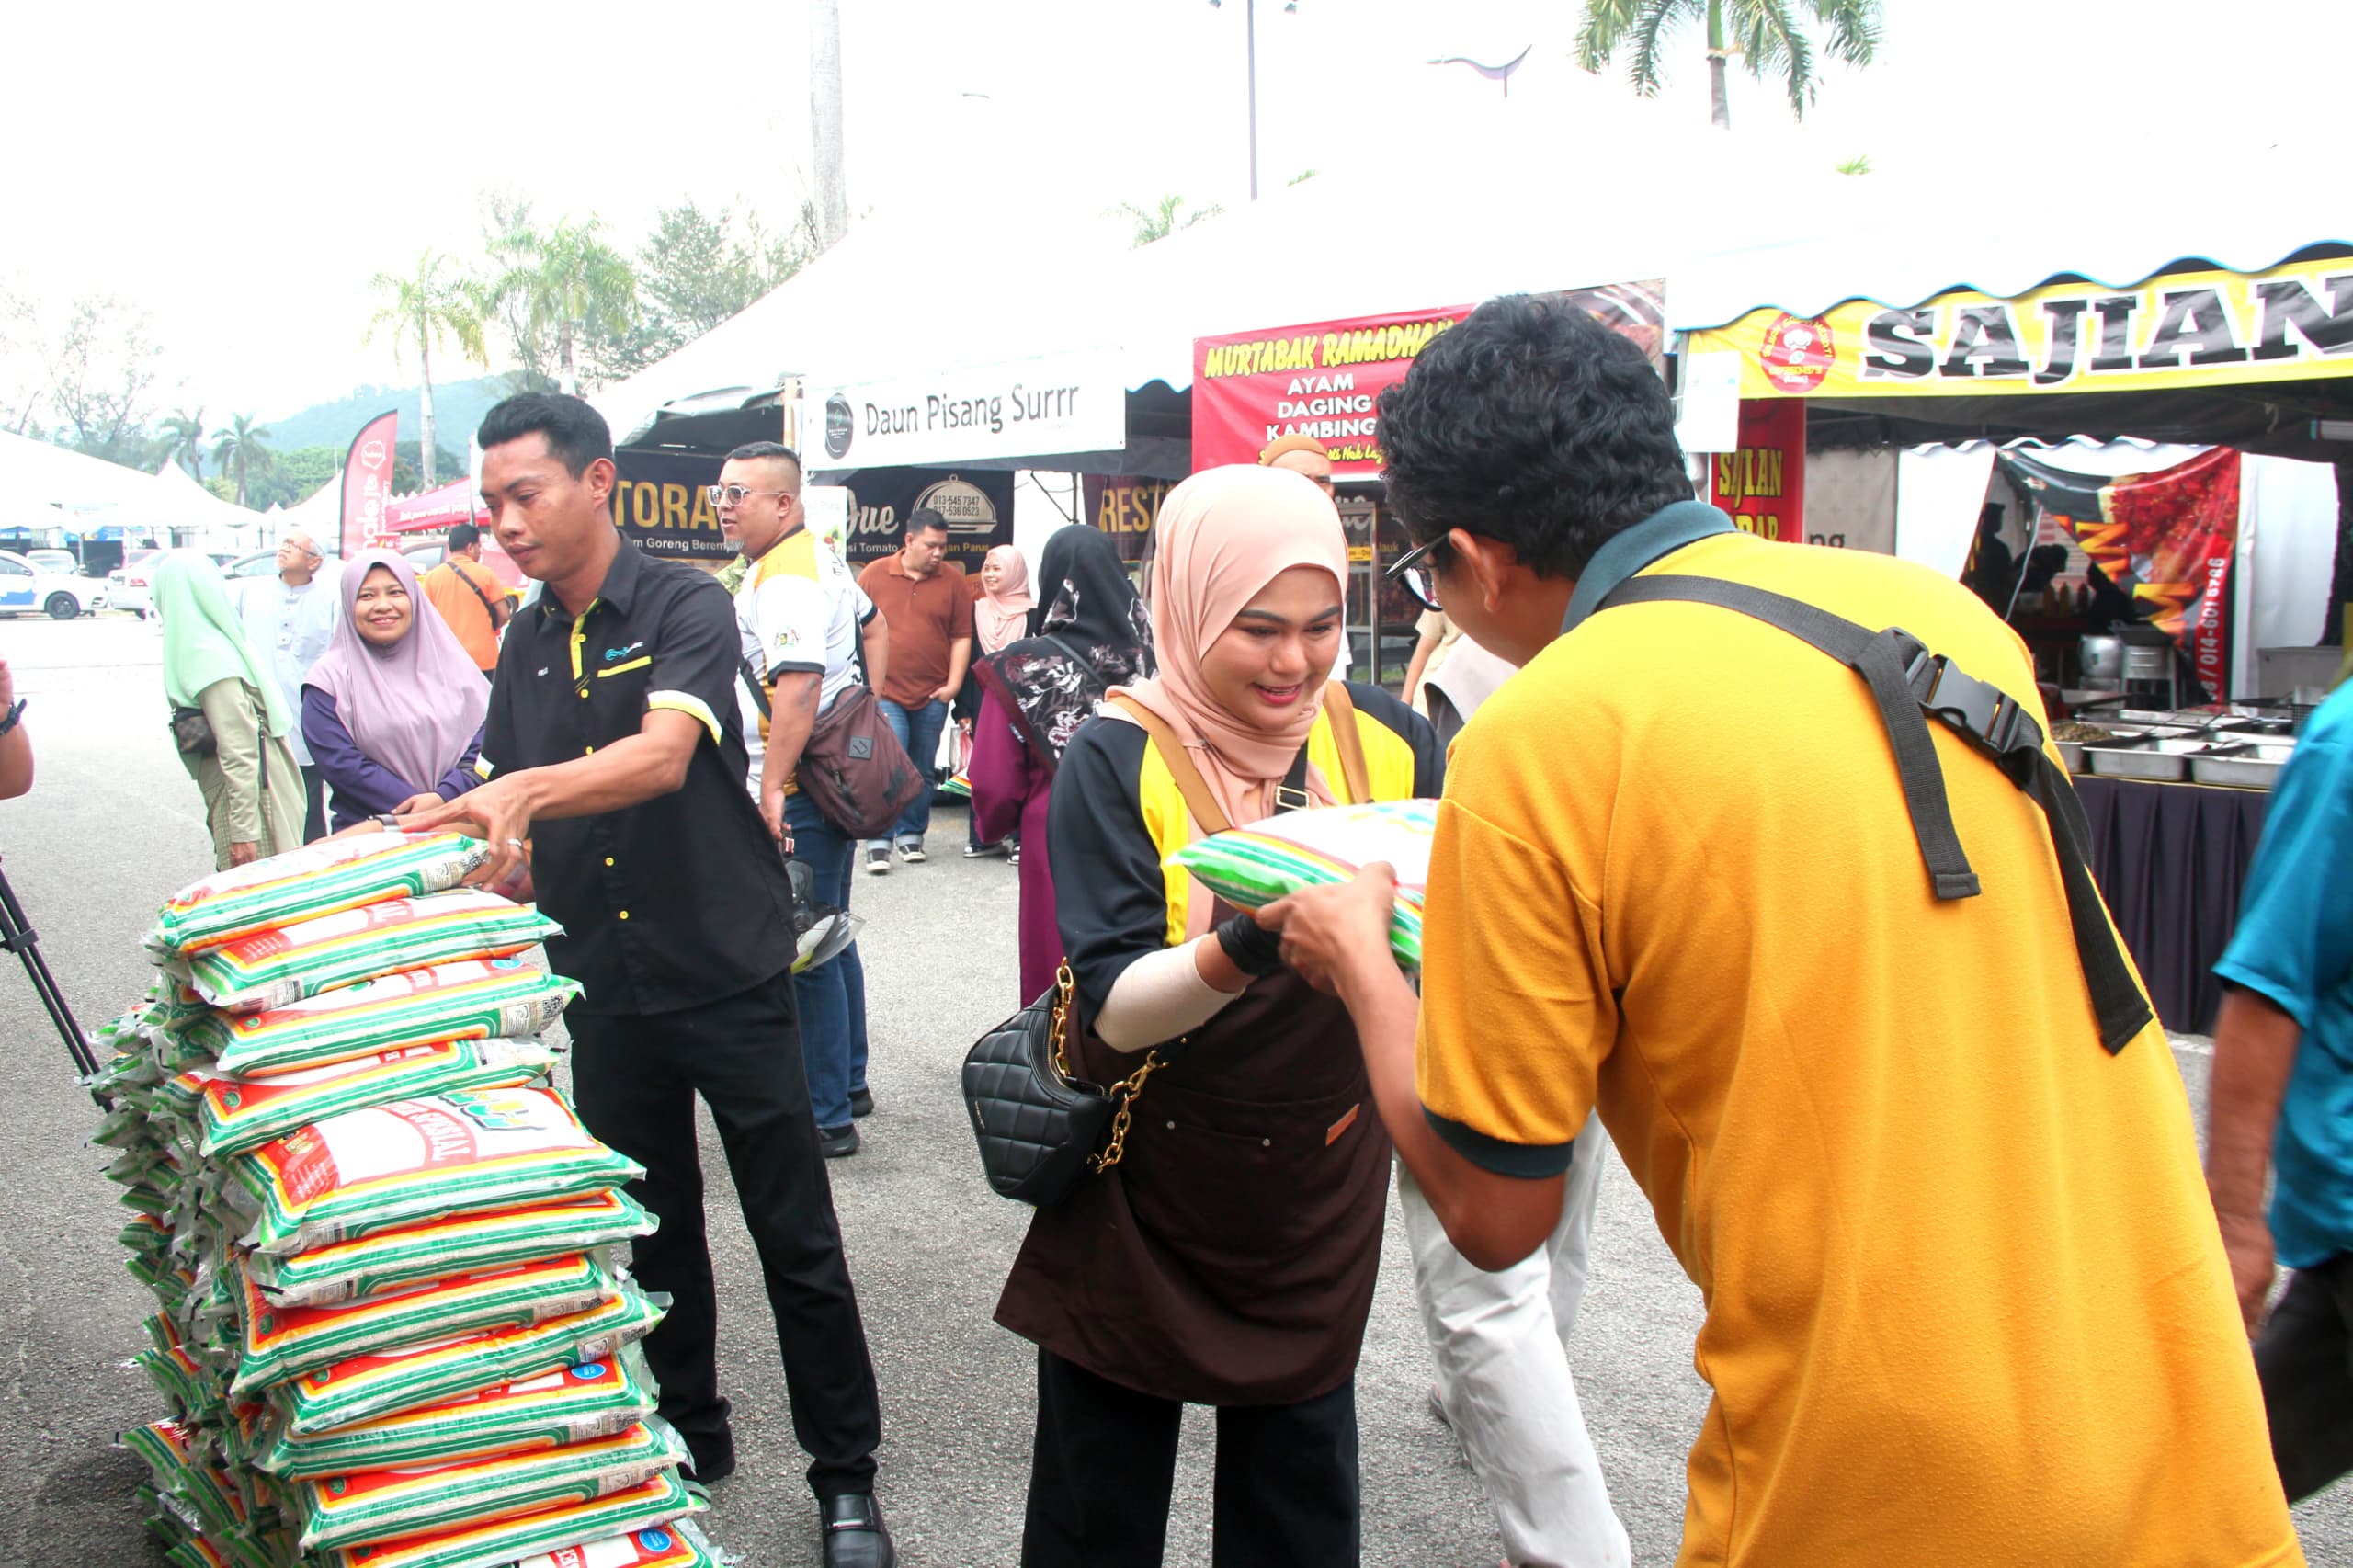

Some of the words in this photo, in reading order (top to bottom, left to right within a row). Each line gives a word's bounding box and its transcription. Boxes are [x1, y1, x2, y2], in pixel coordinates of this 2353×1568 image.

[1862, 273, 2353, 385] SAJIAN
[1204, 335, 1318, 378] MURTABAK
[1287, 373, 1354, 395] AYAM
[865, 403, 918, 436] Daun
[926, 393, 1003, 434] Pisang
[1012, 383, 1079, 422] Surrr
[1278, 395, 1371, 418] DAGING
[1267, 418, 1375, 442] KAMBING
[615, 481, 718, 530] TORA
[1099, 485, 1176, 532] REST
[647, 537, 689, 551] Goreng
[859, 541, 899, 553] Tomato
